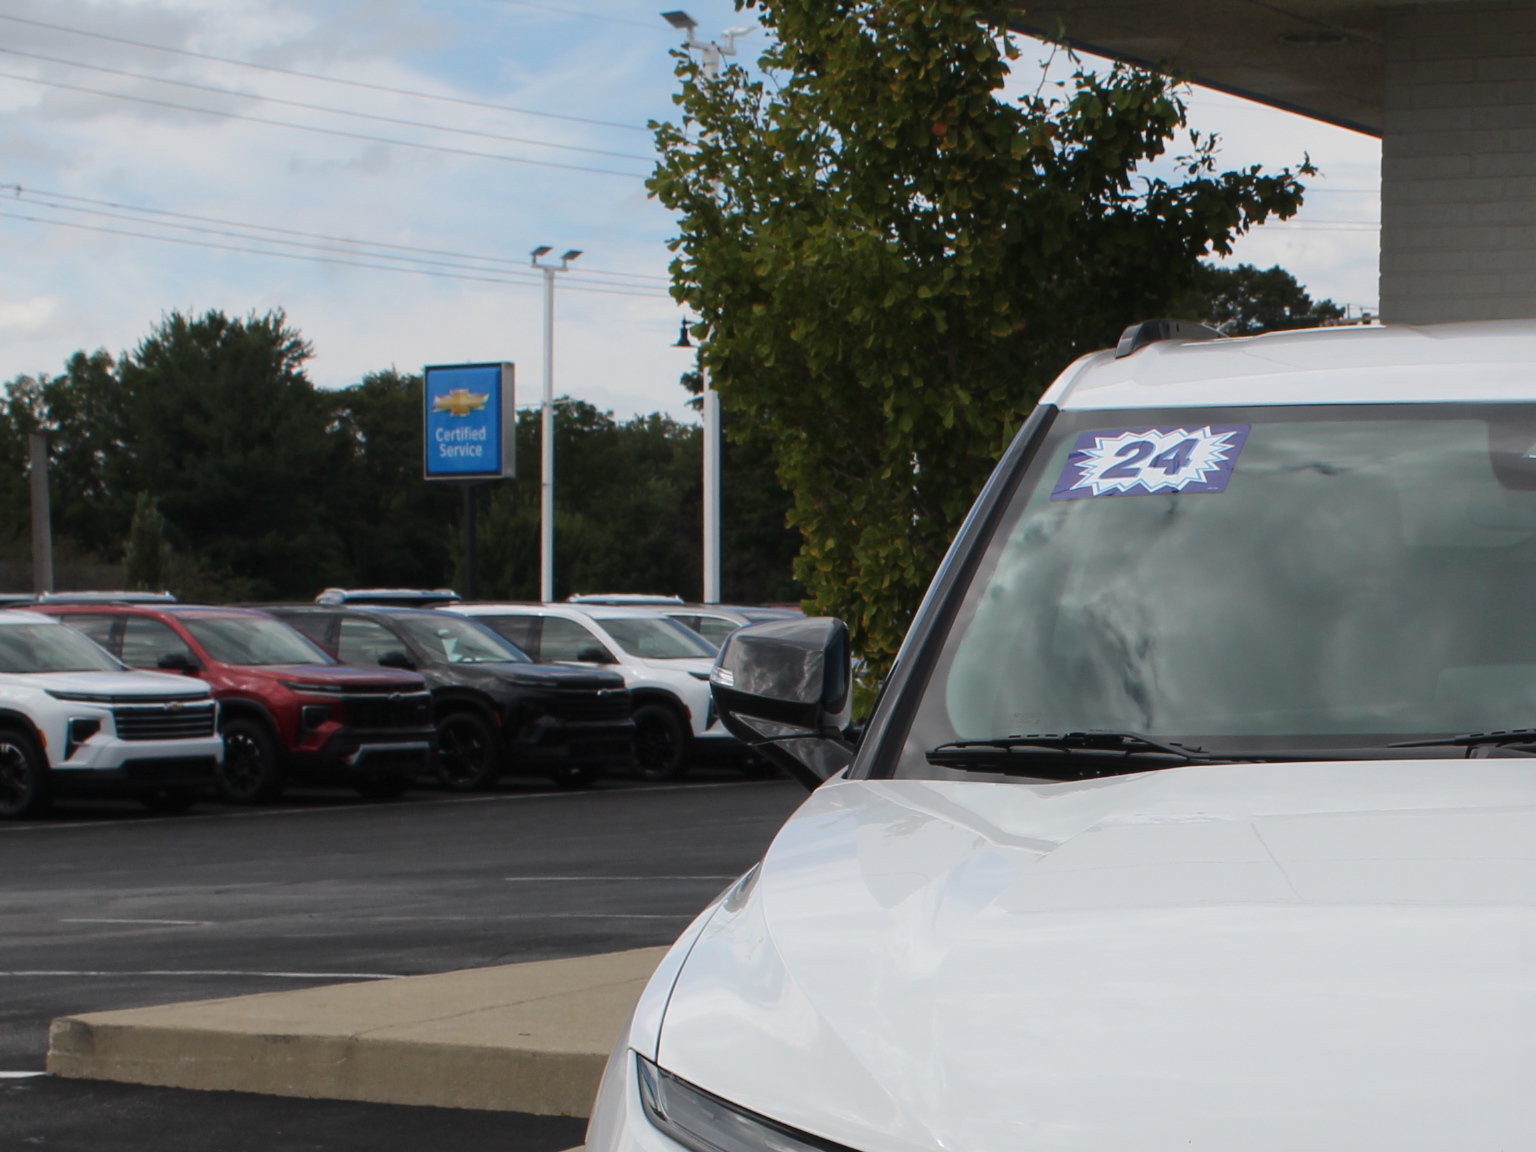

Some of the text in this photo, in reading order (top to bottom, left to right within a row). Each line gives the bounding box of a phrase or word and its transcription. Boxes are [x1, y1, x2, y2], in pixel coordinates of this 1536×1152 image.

[435, 426, 486, 441] Certified
[440, 443, 483, 457] Service
[1100, 438, 1200, 480] 24
